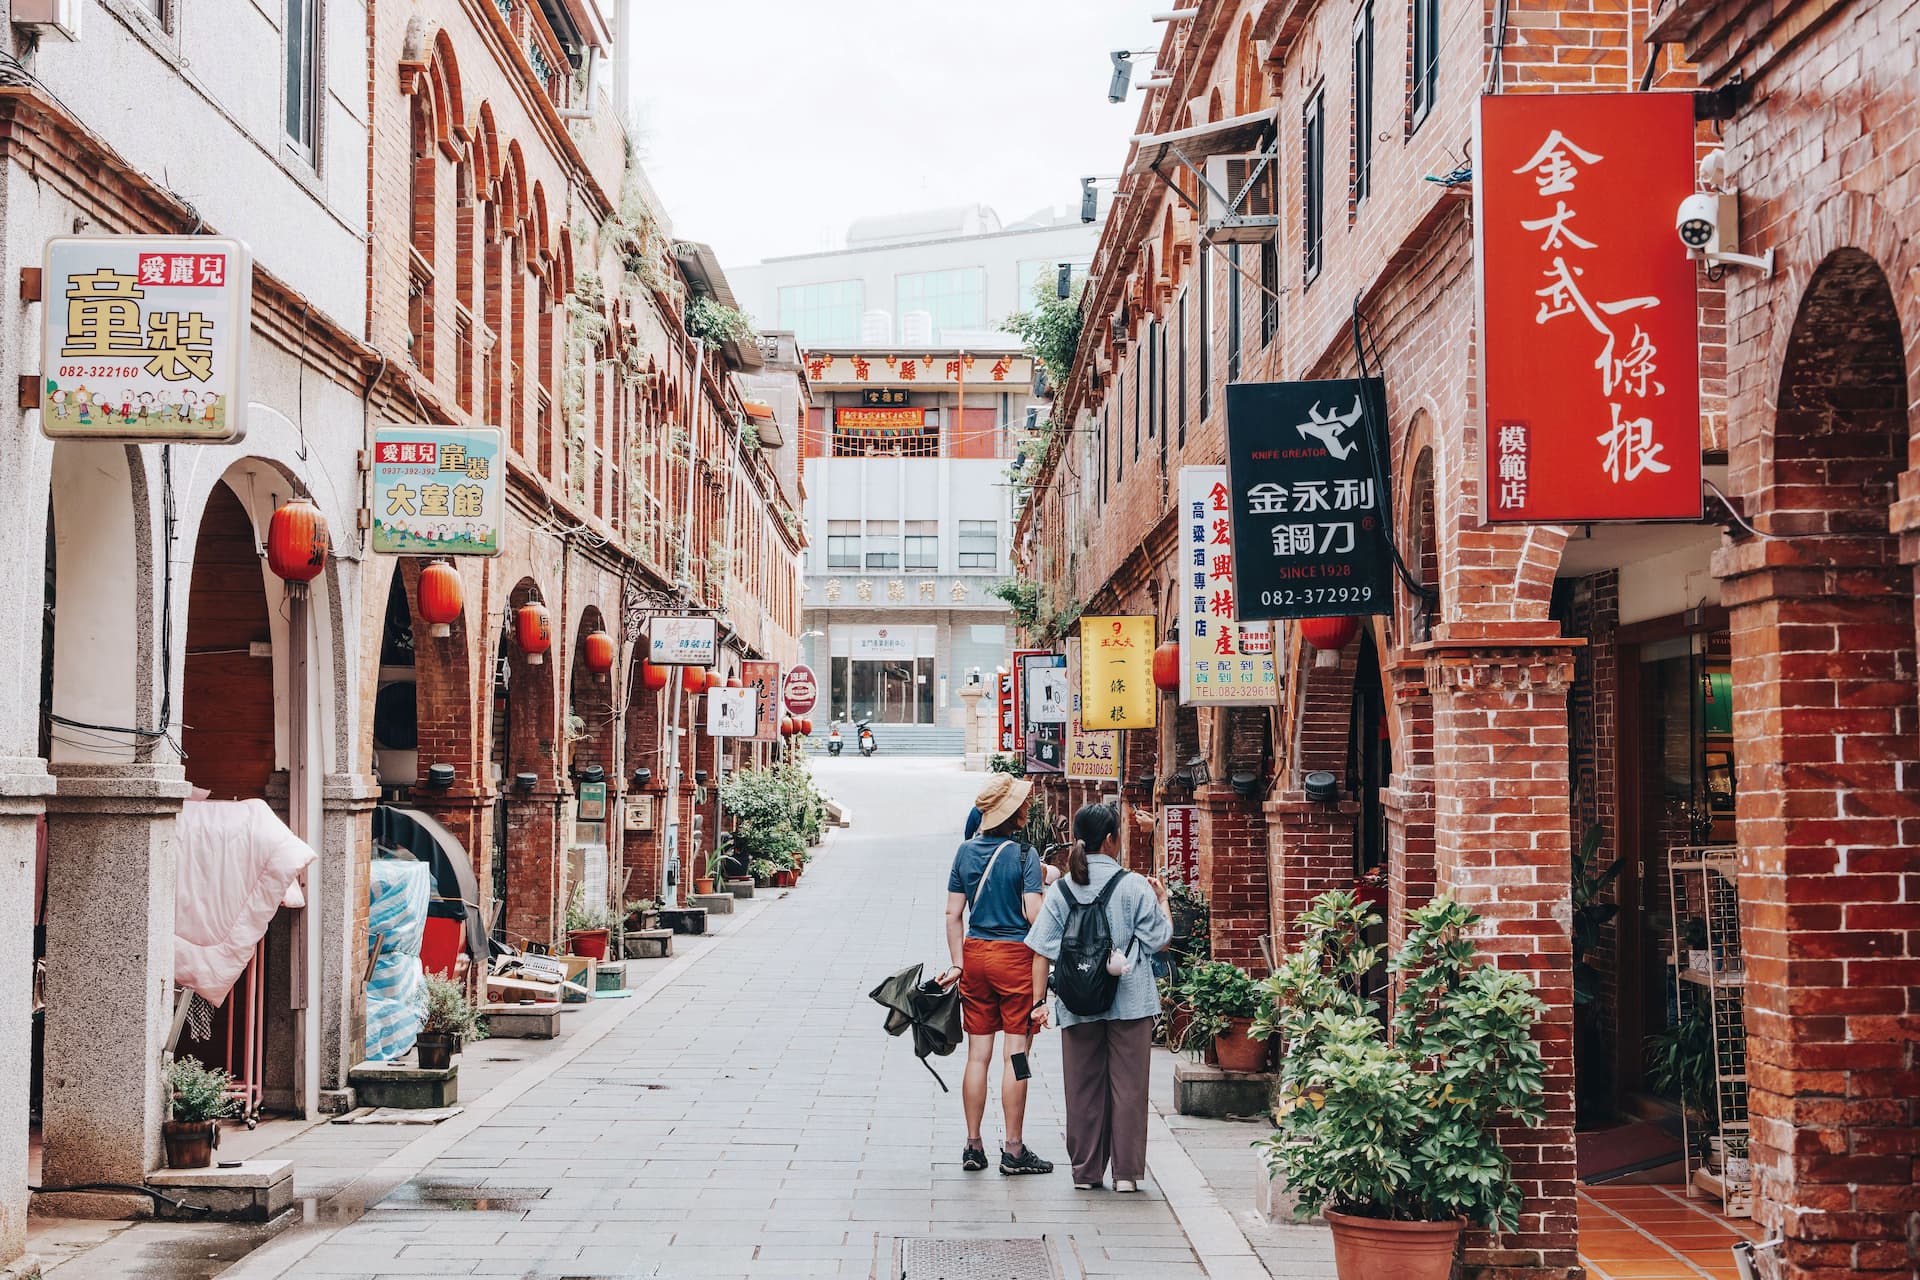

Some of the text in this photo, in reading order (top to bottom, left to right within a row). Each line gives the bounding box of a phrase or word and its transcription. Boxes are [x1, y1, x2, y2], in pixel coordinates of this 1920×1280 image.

[1512, 130, 1611, 335] 金太武
[140, 255, 224, 285] 愛麗兒
[61, 268, 214, 382] 童裝
[59, 366, 139, 378] 082-322160
[1595, 296, 1672, 484] 一條根
[382, 444, 434, 462] 愛麗兒
[439, 443, 489, 480] 童裝
[1498, 425, 1527, 509] 模範店
[386, 483, 484, 517] 大童館
[1247, 477, 1375, 514] 金永利
[1271, 521, 1355, 556] 鋼刀
[1280, 564, 1351, 579] SINCE 1928
[1261, 586, 1372, 606] 082-372929
[1195, 660, 1273, 671] 宅配到家
[1110, 659, 1127, 722] 一條根
